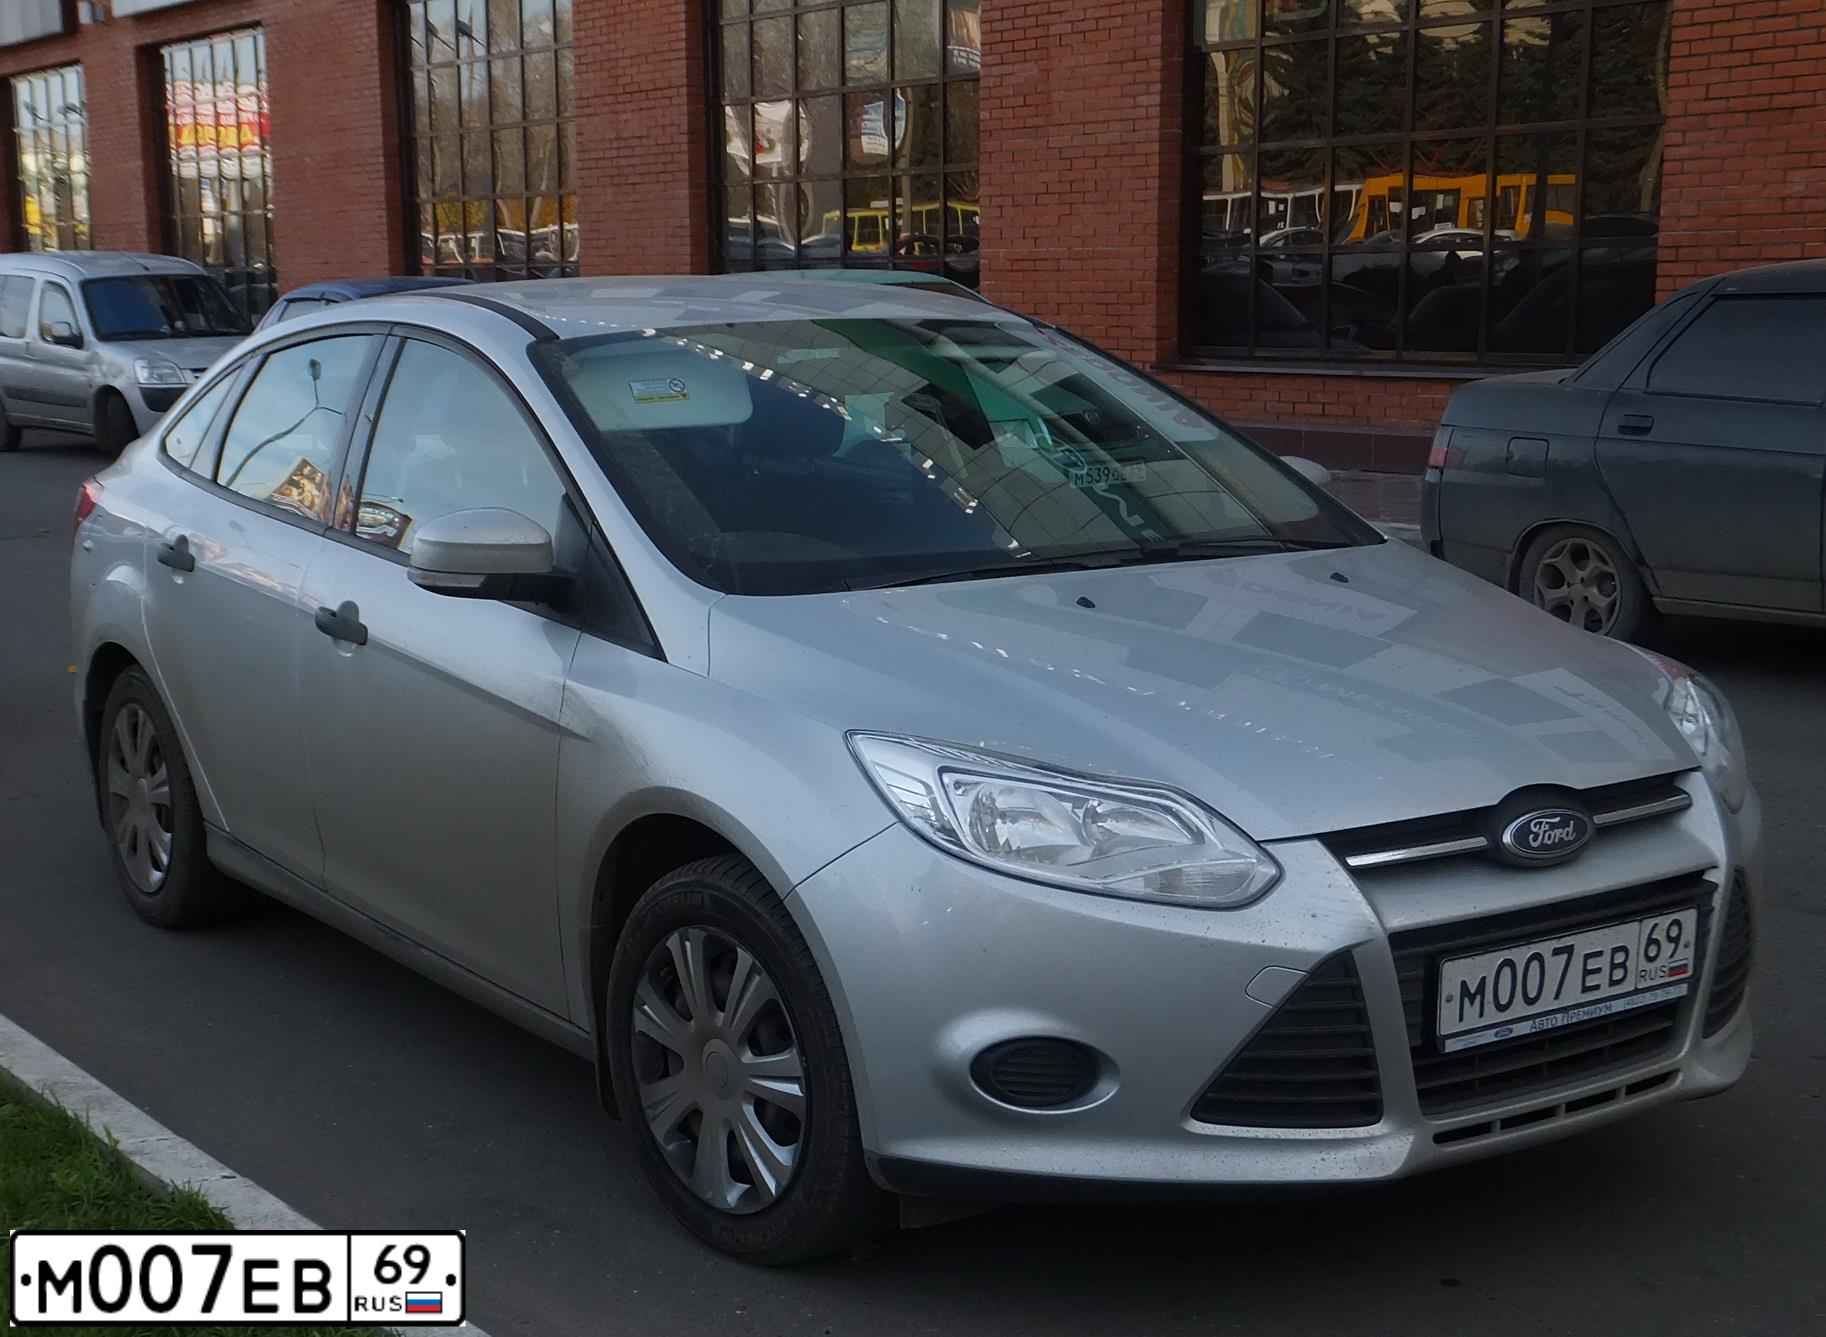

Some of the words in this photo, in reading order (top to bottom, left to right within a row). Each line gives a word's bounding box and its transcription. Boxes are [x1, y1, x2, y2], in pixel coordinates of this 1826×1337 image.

[1528, 816, 1577, 848] Ford
[1642, 917, 1683, 963] 69
[1457, 943, 1630, 1023] М007ЕВ
[1638, 964, 1668, 982] RUS
